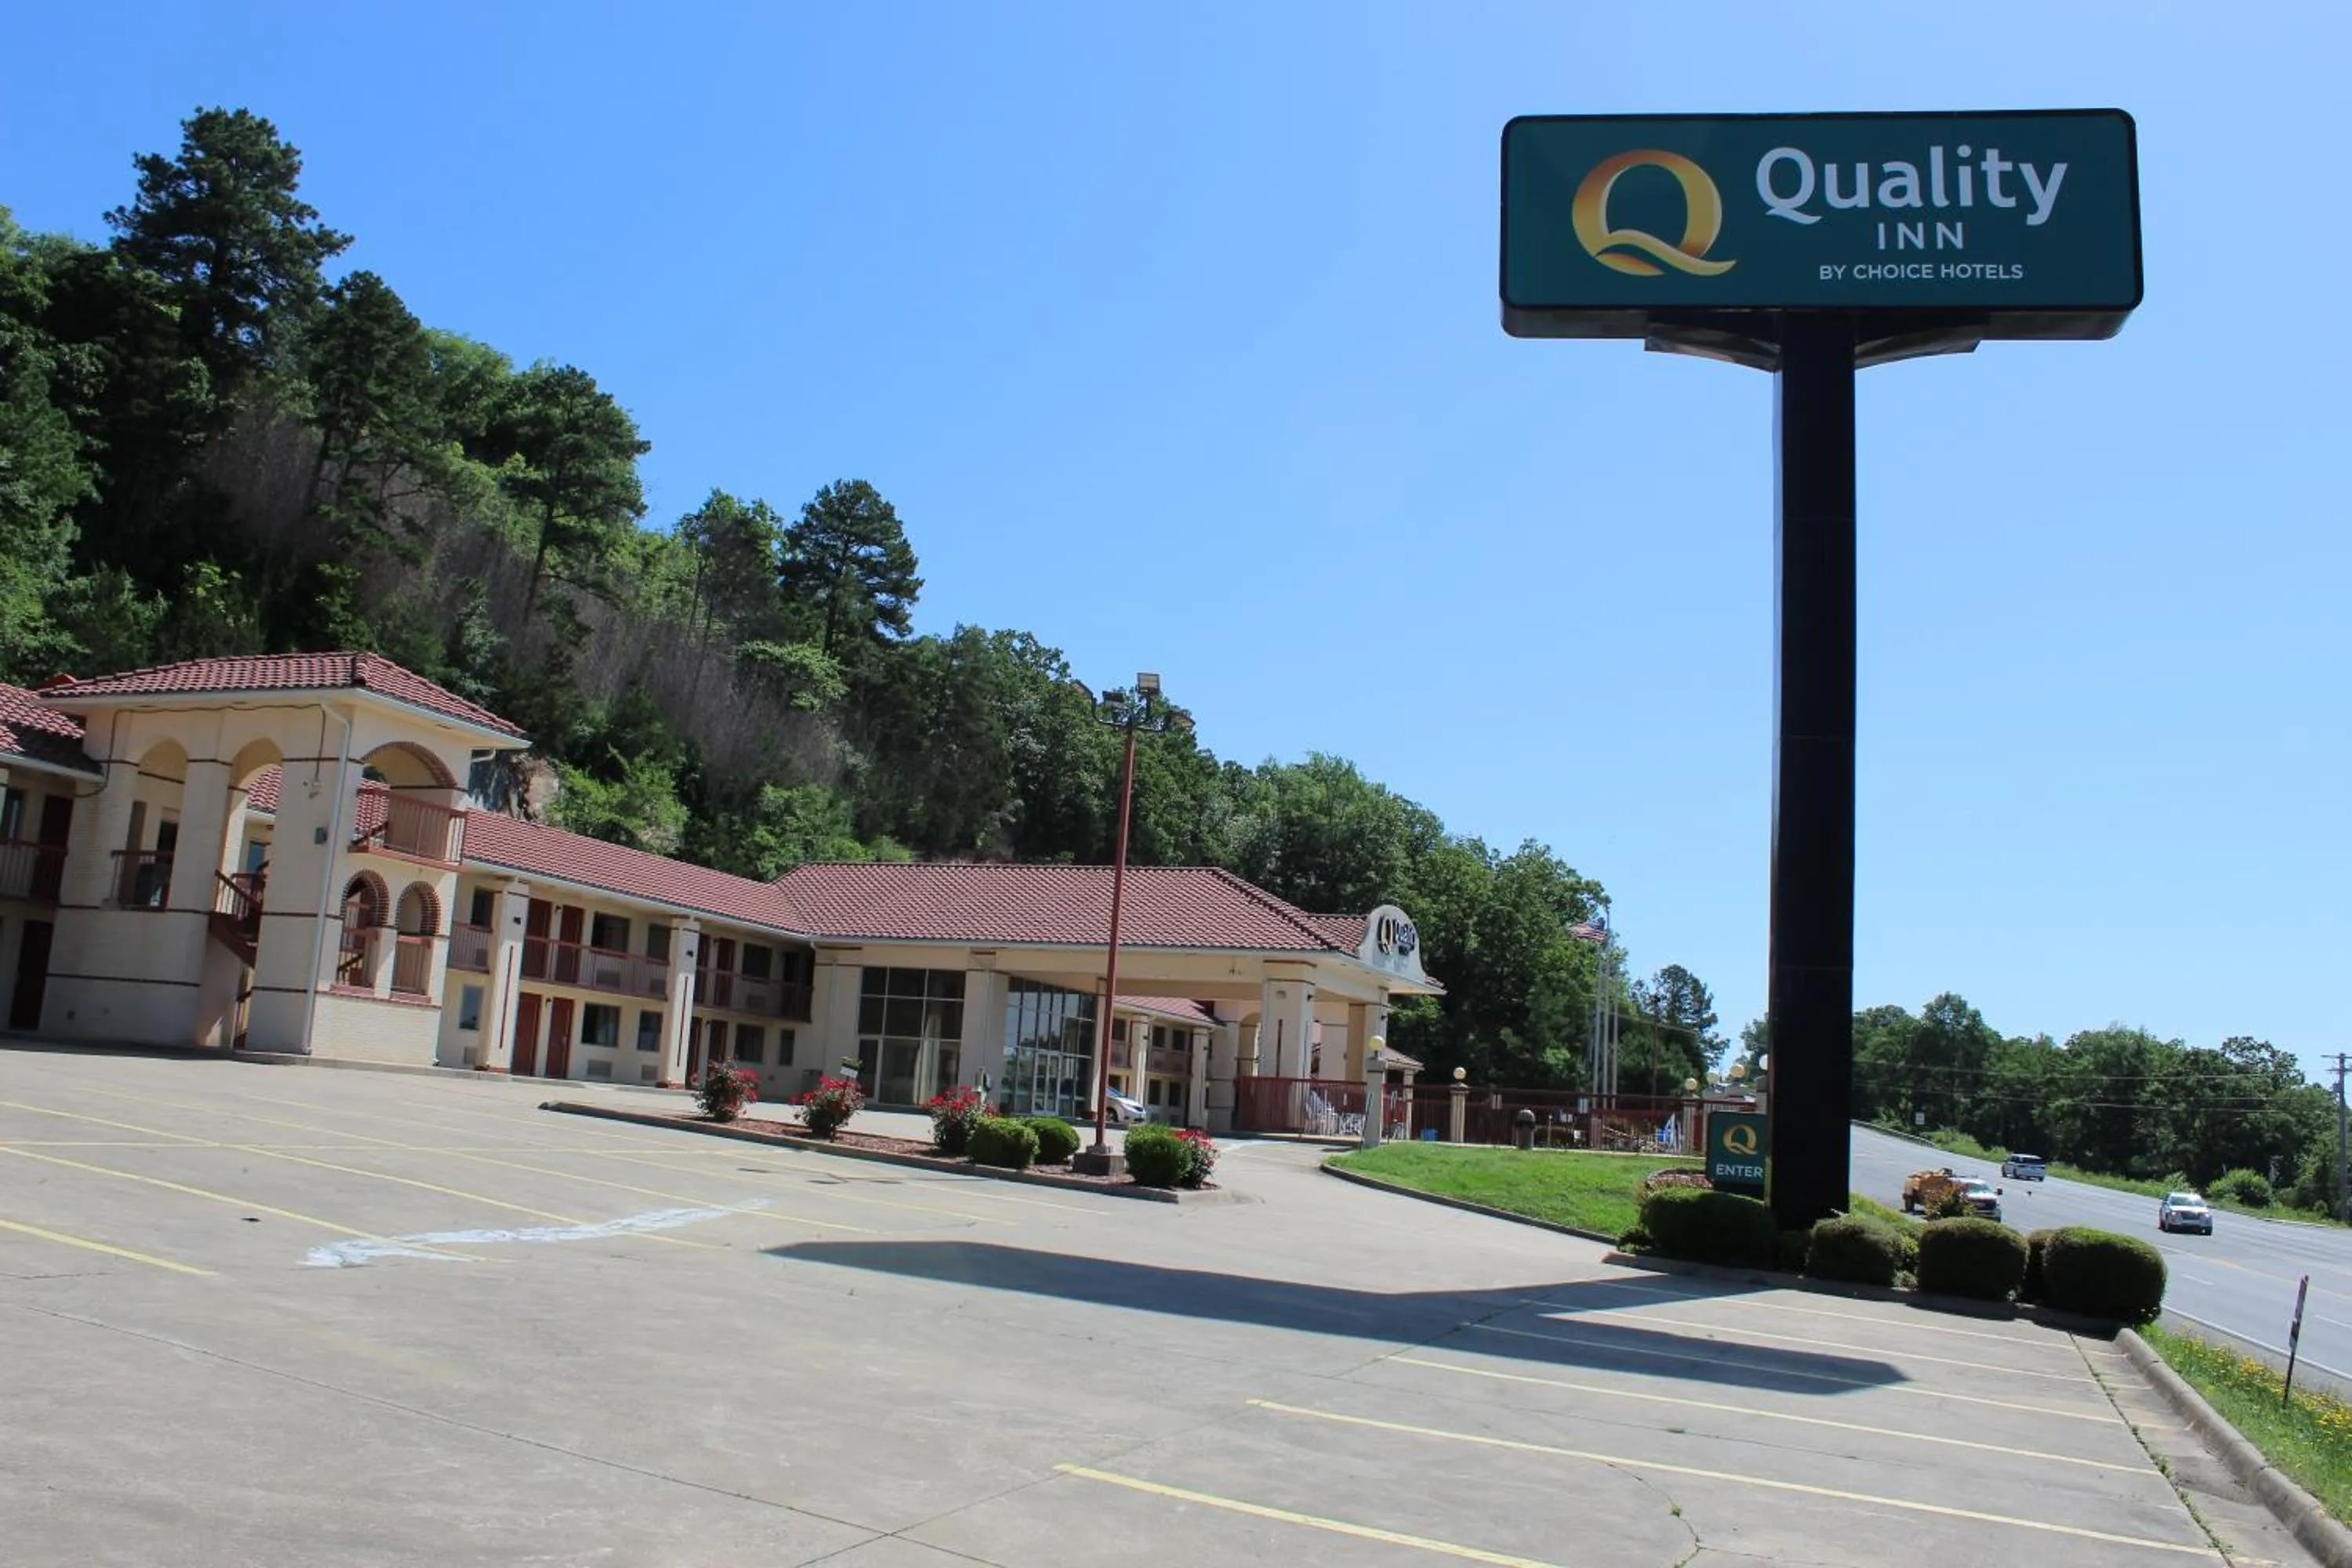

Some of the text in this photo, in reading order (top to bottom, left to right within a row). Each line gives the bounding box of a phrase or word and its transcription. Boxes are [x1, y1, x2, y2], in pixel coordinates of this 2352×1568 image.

[1755, 144, 2068, 226] Quality
[1572, 148, 1737, 277] Q
[1877, 222, 1964, 250] INN
[1819, 263, 2024, 281] BY CHOICE HOTELS
[1722, 1123, 1758, 1155] Q
[1715, 1163, 1763, 1179] ENTER
